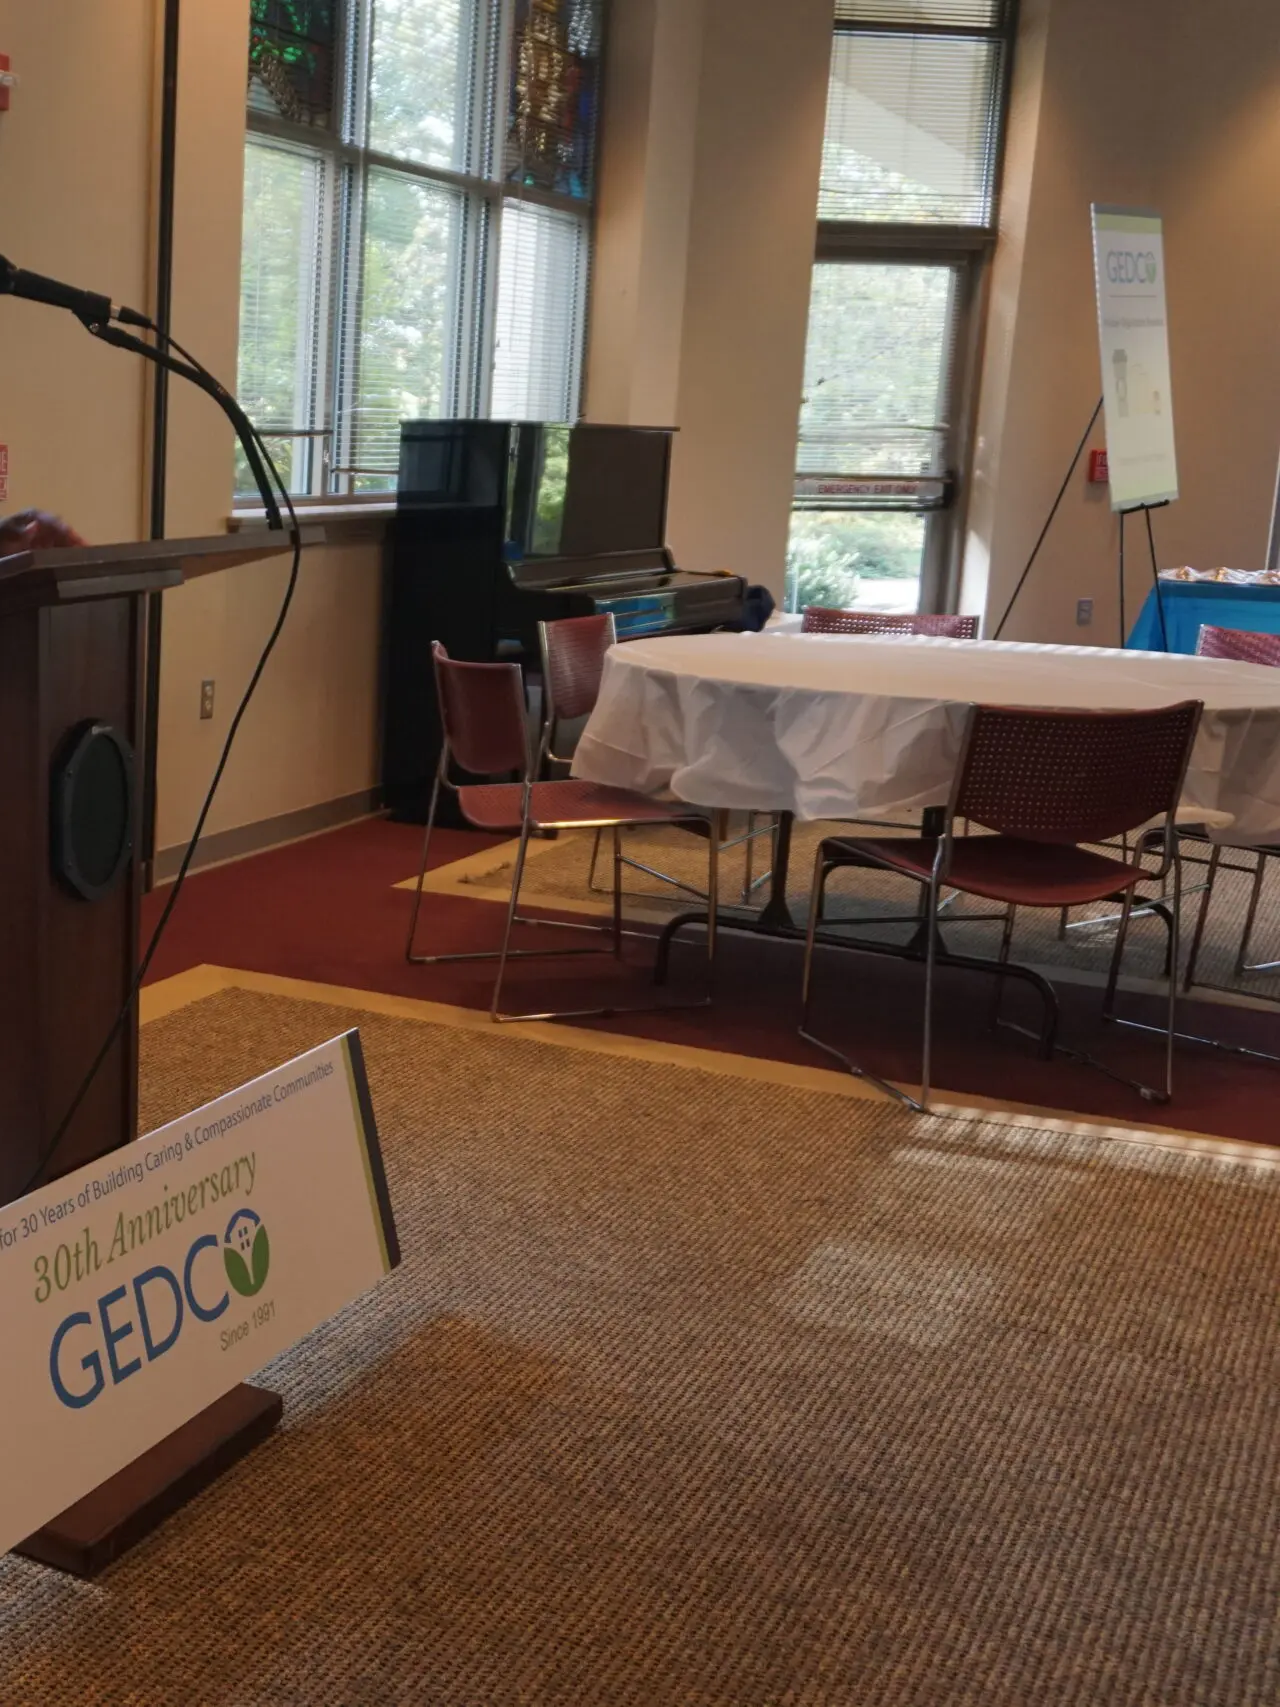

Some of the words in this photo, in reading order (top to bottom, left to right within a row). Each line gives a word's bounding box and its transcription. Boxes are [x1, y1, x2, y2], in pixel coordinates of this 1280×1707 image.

[20, 1213, 38, 1238] 30
[39, 1198, 76, 1227] Years
[77, 1183, 91, 1208] of
[92, 1161, 144, 1201] Building
[144, 1141, 183, 1172] Caring
[184, 1132, 194, 1151] &
[195, 1094, 273, 1146] Compassionate
[273, 1060, 335, 1103] Communities
[33, 1227, 102, 1304] 30th
[106, 1152, 257, 1264] Anniversary
[220, 1321, 249, 1352] Since
[252, 1300, 276, 1329] 1991
